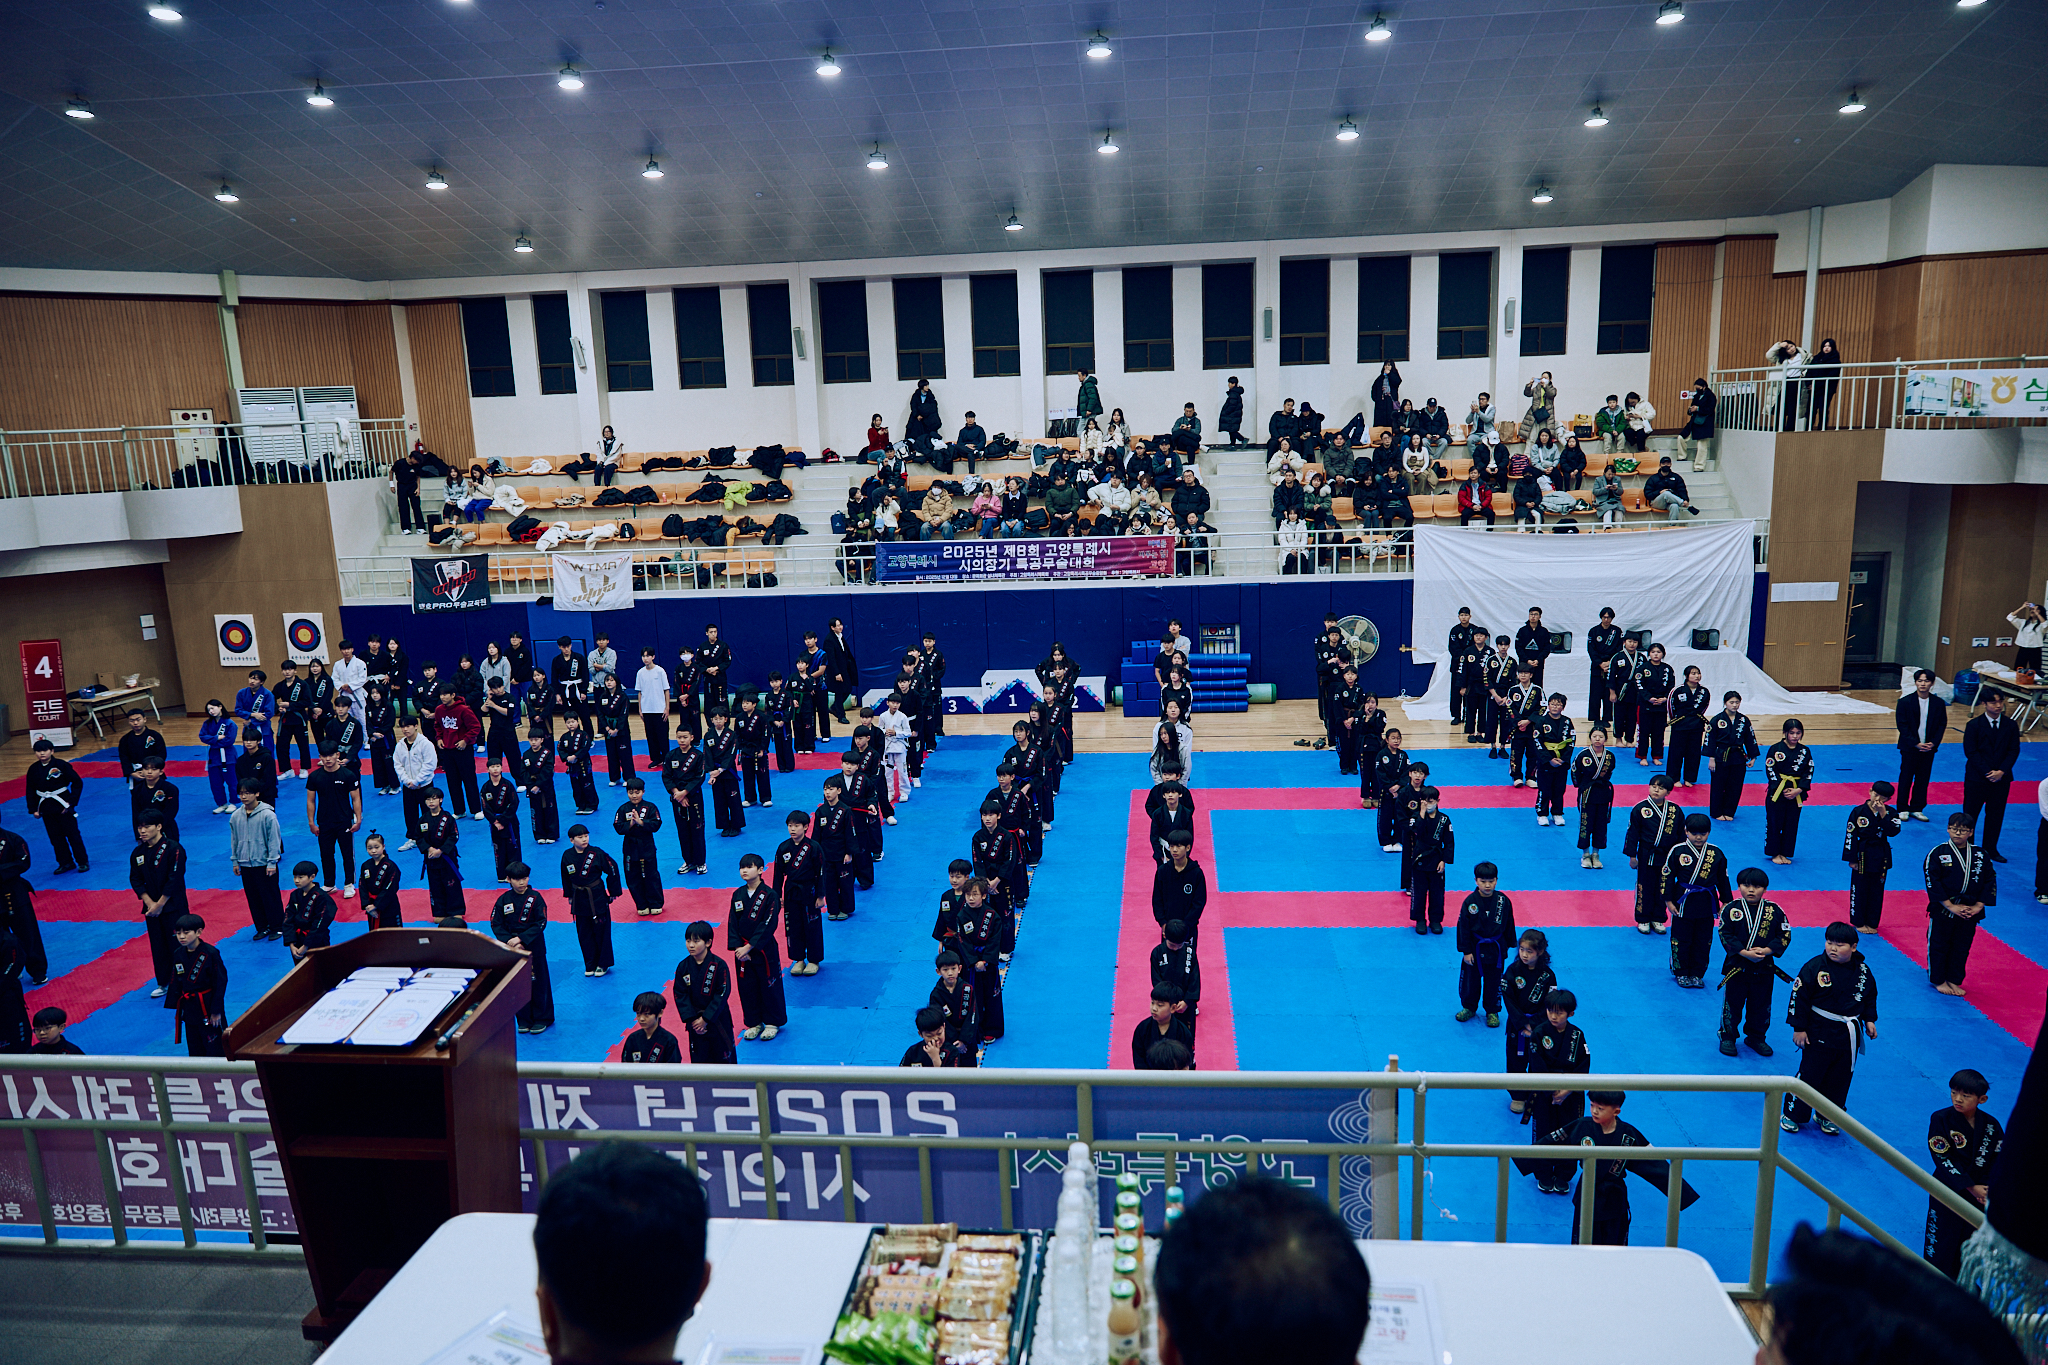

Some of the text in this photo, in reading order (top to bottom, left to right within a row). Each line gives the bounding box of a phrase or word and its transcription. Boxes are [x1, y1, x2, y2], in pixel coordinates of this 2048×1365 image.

[943, 541, 1111, 558] 2025년 제8회 고양특례시
[570, 561, 617, 572] WTMA
[888, 554, 938, 569] 고양특례시
[959, 556, 1095, 572] 시의장기 특공무술대회
[34, 655, 53, 679] 4
[32, 699, 65, 715] 코트
[948, 700, 957, 713] 3
[1008, 694, 1018, 707] 1
[1071, 695, 1079, 709] 2
[38, 714, 60, 722] COURT
